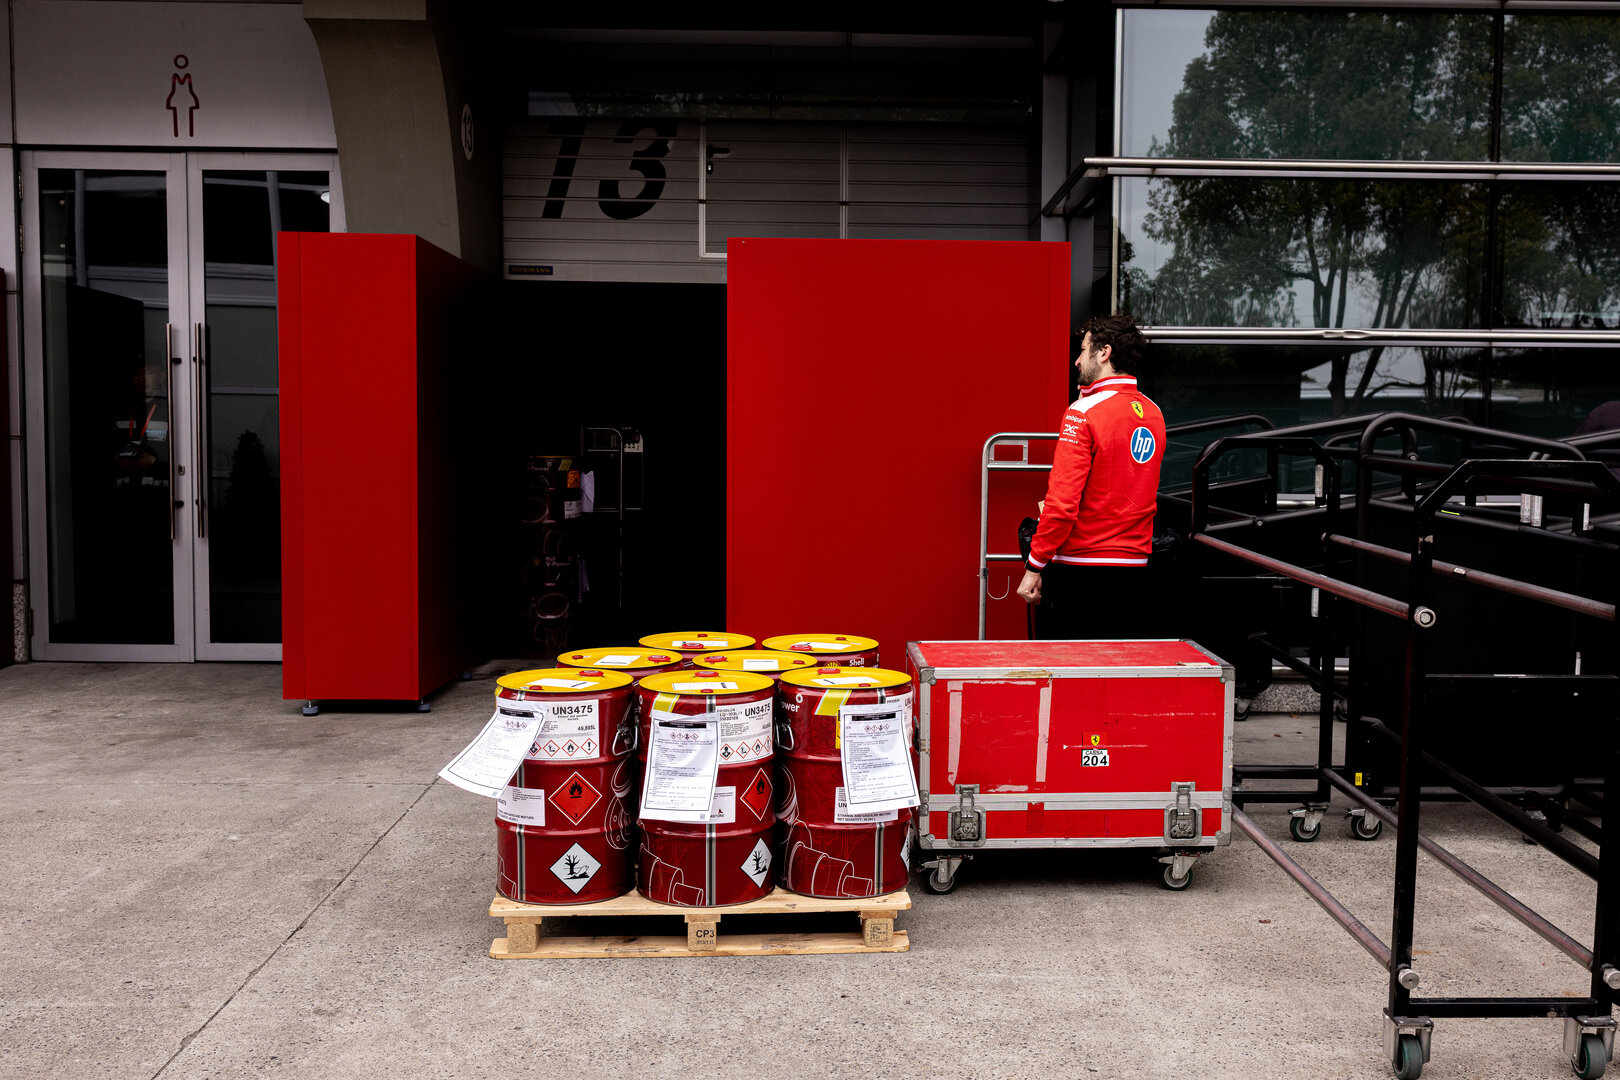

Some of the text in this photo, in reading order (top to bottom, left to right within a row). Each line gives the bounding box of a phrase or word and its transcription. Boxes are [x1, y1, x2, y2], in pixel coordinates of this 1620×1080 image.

[463, 110, 473, 154] 13
[541, 118, 678, 220] 13
[1133, 428, 1153, 463] hp
[849, 657, 865, 667] Shell
[552, 704, 593, 716] UN3475
[744, 702, 771, 717] UN3475
[1083, 755, 1108, 766] 204
[695, 929, 715, 938] CP3
